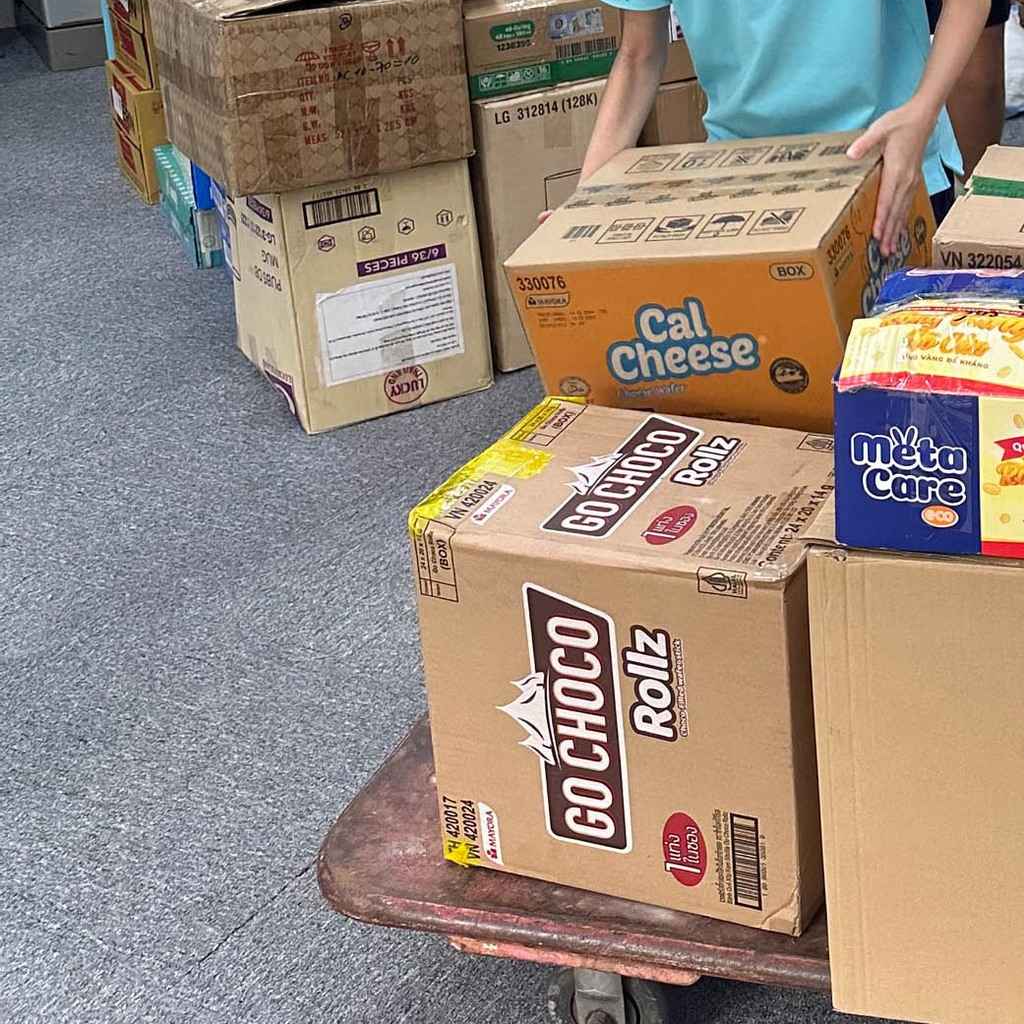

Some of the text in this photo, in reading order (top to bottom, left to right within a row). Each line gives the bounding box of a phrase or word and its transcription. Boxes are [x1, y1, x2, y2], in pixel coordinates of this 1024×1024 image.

[494, 92, 598, 125] LG 312814 (128K)
[363, 247, 440, 274] 6/36 PIECES
[775, 262, 807, 278] BOX
[940, 251, 1023, 270] VN 322054
[515, 275, 567, 292] 330076
[637, 299, 709, 344] Cal
[609, 333, 760, 382] Cheese
[389, 378, 426, 398] LUCKY
[560, 428, 688, 533] GO CHOCO
[671, 436, 739, 486] Rollz
[445, 479, 498, 522] VN 420024
[862, 466, 967, 506] Care
[786, 521, 800, 534] 24
[801, 505, 815, 519] 20
[432, 538, 455, 571] (BOX)
[624, 626, 676, 741] Rollz
[545, 614, 617, 841] GO CHOCO
[442, 795, 461, 838] 420017
[460, 799, 481, 859] VN 420024
[485, 810, 497, 847] MAYORA
